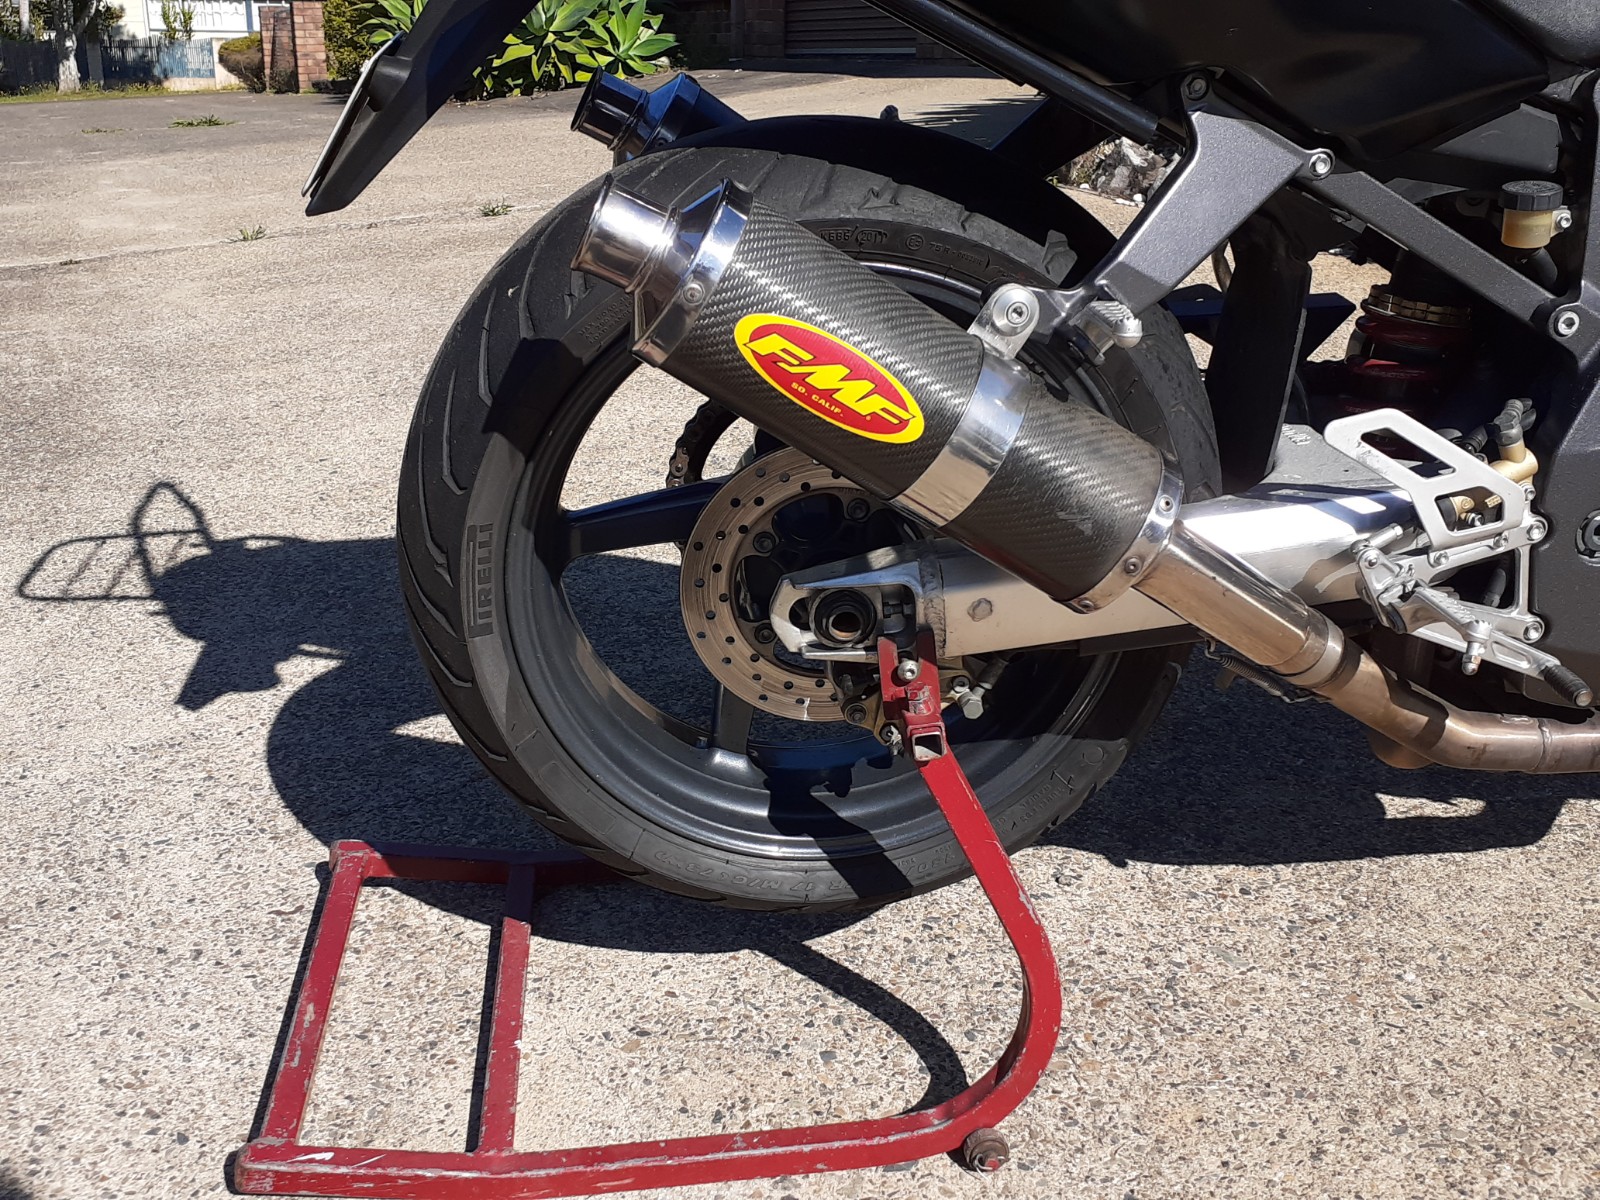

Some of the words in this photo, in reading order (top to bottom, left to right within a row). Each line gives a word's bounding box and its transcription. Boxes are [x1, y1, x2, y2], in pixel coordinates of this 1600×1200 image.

[743, 333, 916, 425] FMF
[791, 381, 808, 397] SO.
[811, 393, 844, 418] CALIF.
[467, 522, 494, 639] PIRELLI
